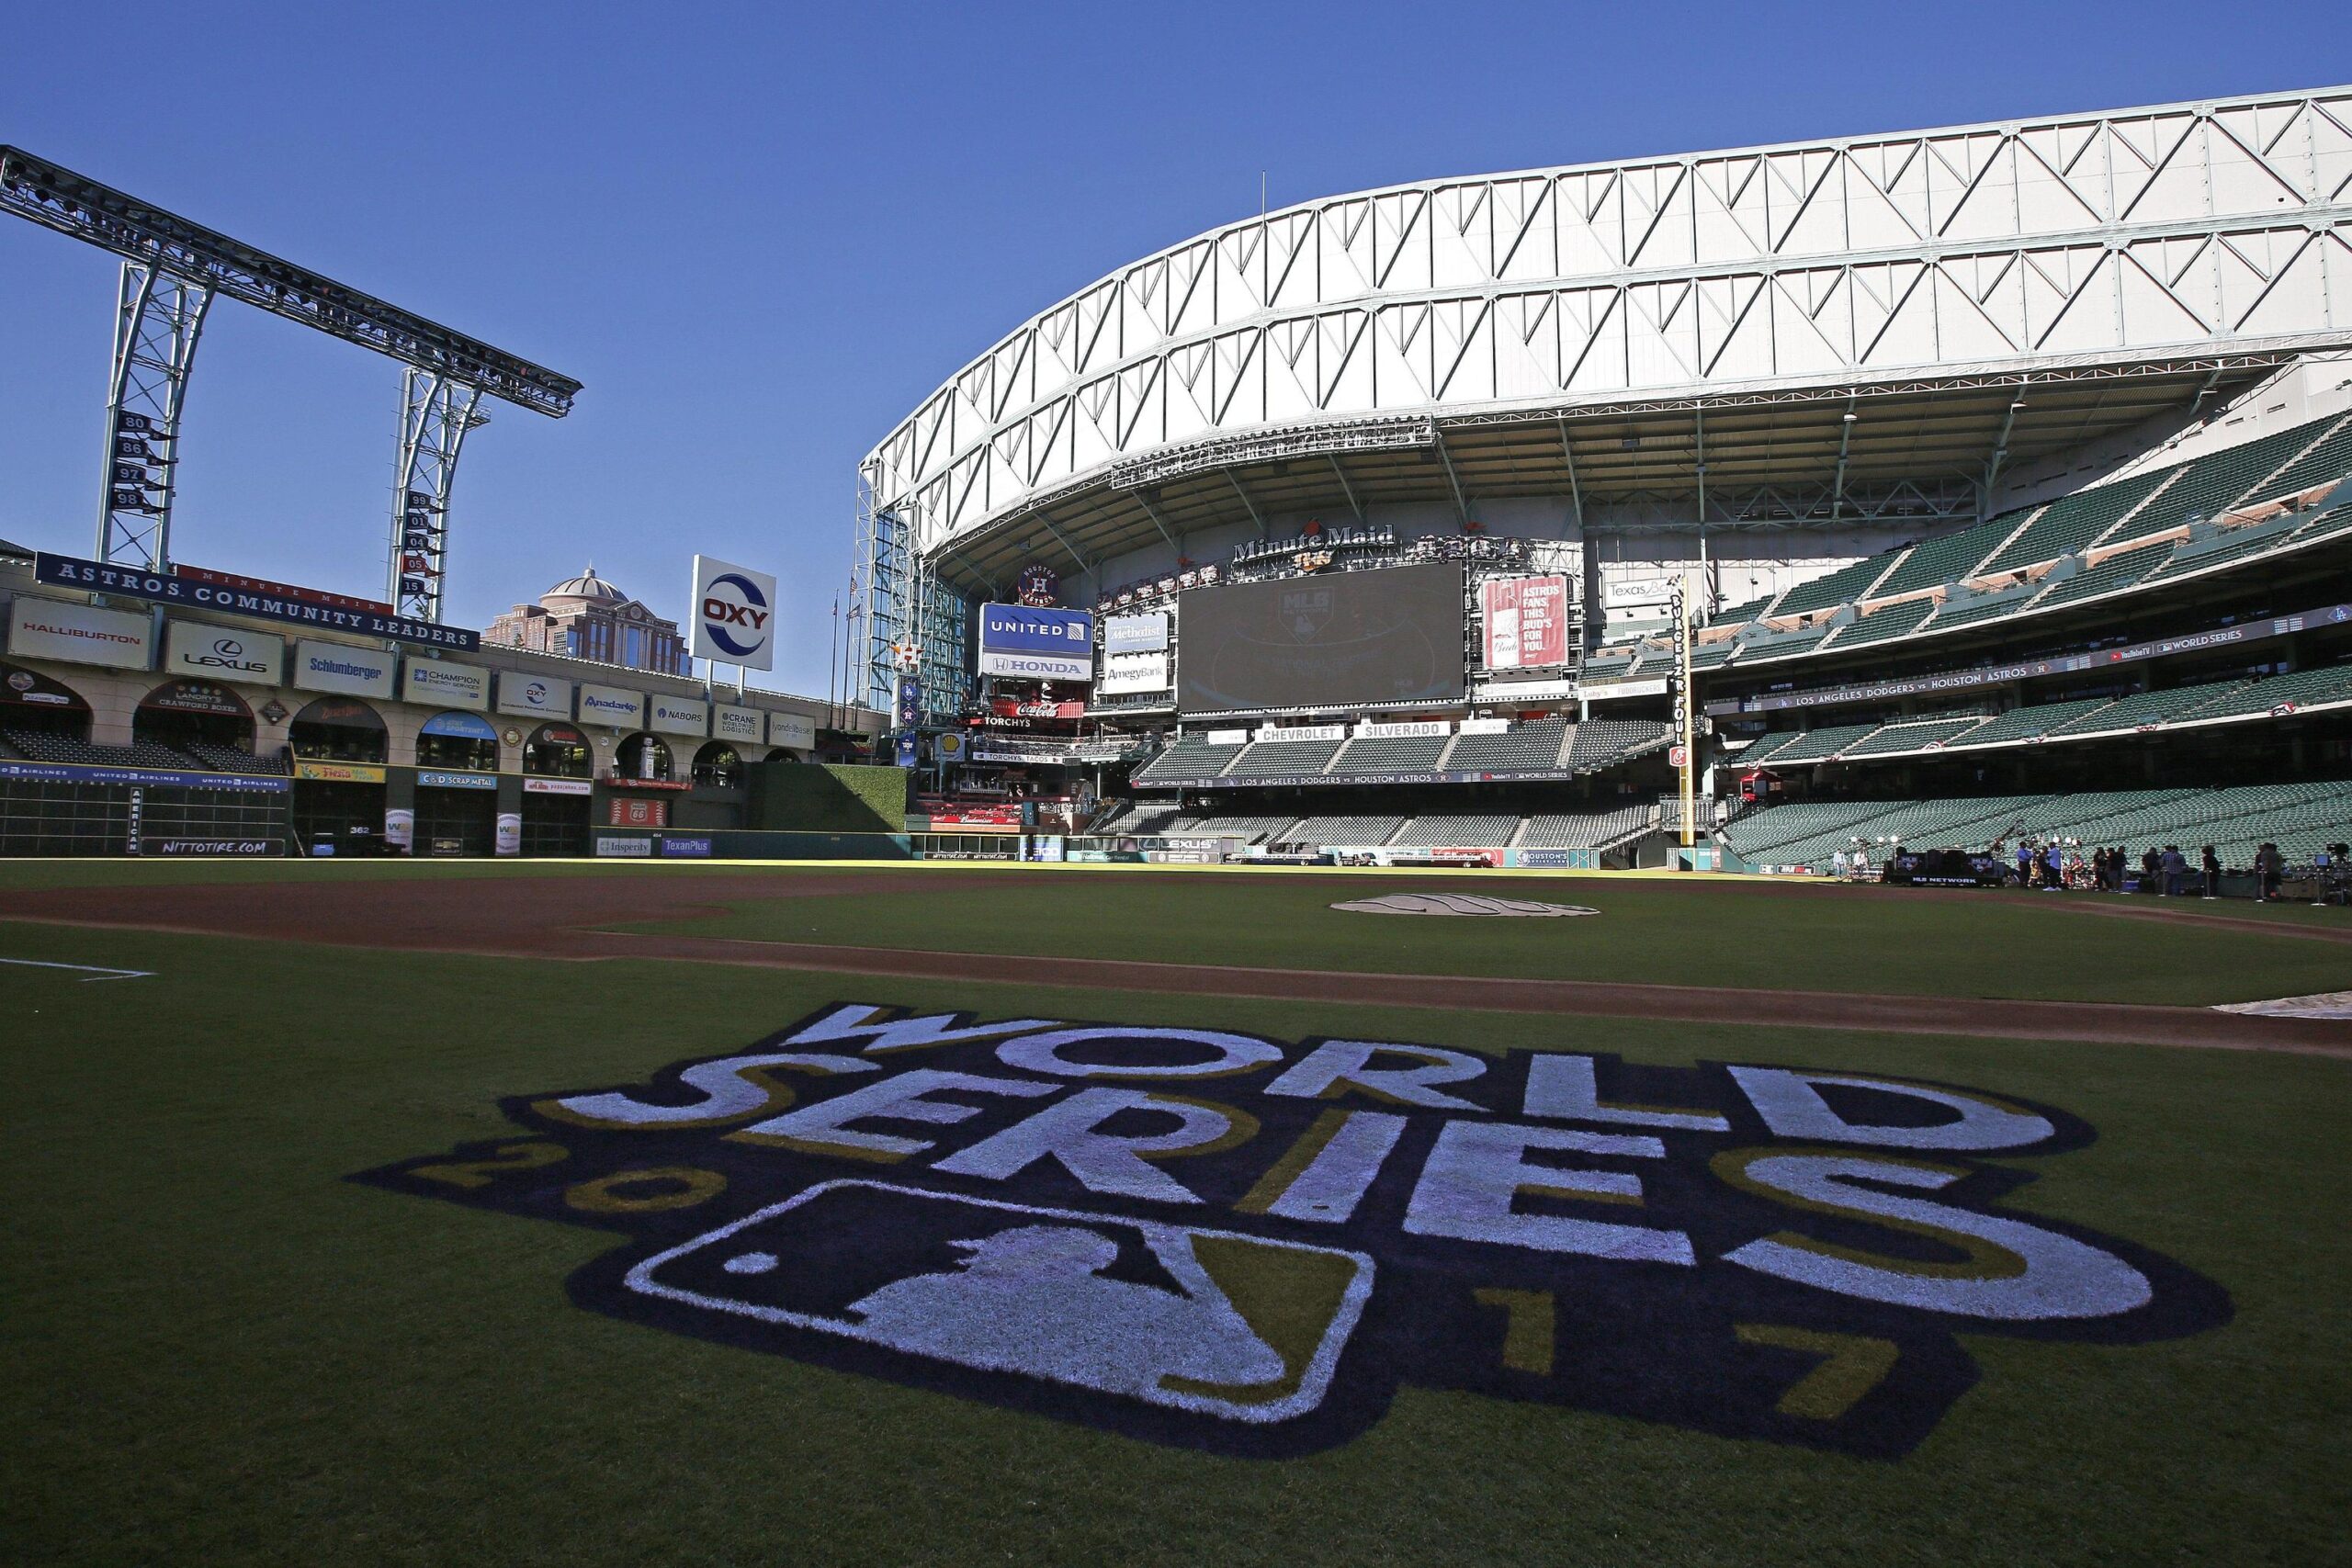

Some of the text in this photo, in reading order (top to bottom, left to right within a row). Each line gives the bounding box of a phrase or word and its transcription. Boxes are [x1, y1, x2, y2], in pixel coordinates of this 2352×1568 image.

[125, 417, 144, 428] 80
[122, 443, 141, 454] 86
[119, 468, 139, 479] 97
[118, 494, 137, 504] 98
[413, 496, 426, 504] 99
[412, 517, 424, 525] 01
[410, 538, 424, 547] 04
[1233, 525, 1395, 563] Minute Maid
[409, 560, 422, 569] 05
[1023, 565, 1056, 579] HOUSTON
[203, 572, 376, 610] MINUTE MAID
[405, 581, 418, 591] 15
[1033, 578, 1047, 592] H
[1523, 585, 1560, 597] ASTROS
[1611, 584, 1645, 597] Texas
[58, 563, 468, 645] ASTROS COMMUNITY LEADERS
[1023, 593, 1054, 604] ASTROS
[1283, 592, 1329, 608] MLB
[1523, 597, 1550, 608] FANS,
[704, 598, 769, 629] OXY
[1523, 608, 1544, 619] THIS
[991, 621, 1063, 636] UNITED
[1523, 619, 1553, 630] BUD'S
[23, 623, 141, 645] HALLIBURTON
[1110, 626, 1161, 639] Methodist
[1523, 630, 1543, 640] FOR
[2172, 636, 2209, 649] WORLD
[2209, 630, 2243, 643] SERIES
[1523, 641, 1545, 651] YOU.
[184, 653, 267, 673] LEXUS
[310, 658, 382, 680] Schlumberger
[1011, 661, 1082, 674] HONDA
[428, 679, 452, 687] ENERGY
[429, 671, 481, 685] CHAMPION
[1617, 684, 1662, 695] FUDDRUCKERS
[1796, 697, 1815, 705] LOS
[1818, 692, 1862, 704] ANGELES
[1867, 683, 1915, 698] DODGERS
[1931, 674, 1982, 689] HOUSTON
[1986, 667, 2027, 682] ASTROS
[175, 692, 221, 703] LANDRY'S
[526, 689, 547, 697] OXY
[159, 699, 237, 713] CRAWFORD BOXES
[584, 695, 638, 714] Anadarko
[668, 710, 702, 722] NABORS
[729, 714, 756, 725] CRANE
[722, 720, 756, 730] WORLDWIDE
[722, 726, 756, 736] LOGISTICS
[1365, 724, 1440, 737] SILVERADO
[1263, 728, 1336, 740] CHEVROLET
[322, 767, 352, 779] Fiesta
[1354, 775, 1395, 784] HOUSTON
[1399, 774, 1431, 783] ASTROS
[424, 774, 430, 784] C
[438, 775, 446, 784] D
[448, 776, 470, 785] SCRAP
[471, 778, 492, 786] METAL
[632, 809, 645, 818] 66
[960, 814, 993, 824] Budweiser
[130, 790, 141, 851] AMERICAN
[162, 841, 266, 854] NITTOTIRE.COM
[611, 841, 649, 852] Insperity
[665, 840, 707, 851] TexanPlus
[777, 1002, 2056, 1154] WORLD
[531, 1050, 2154, 1323] SERIES
